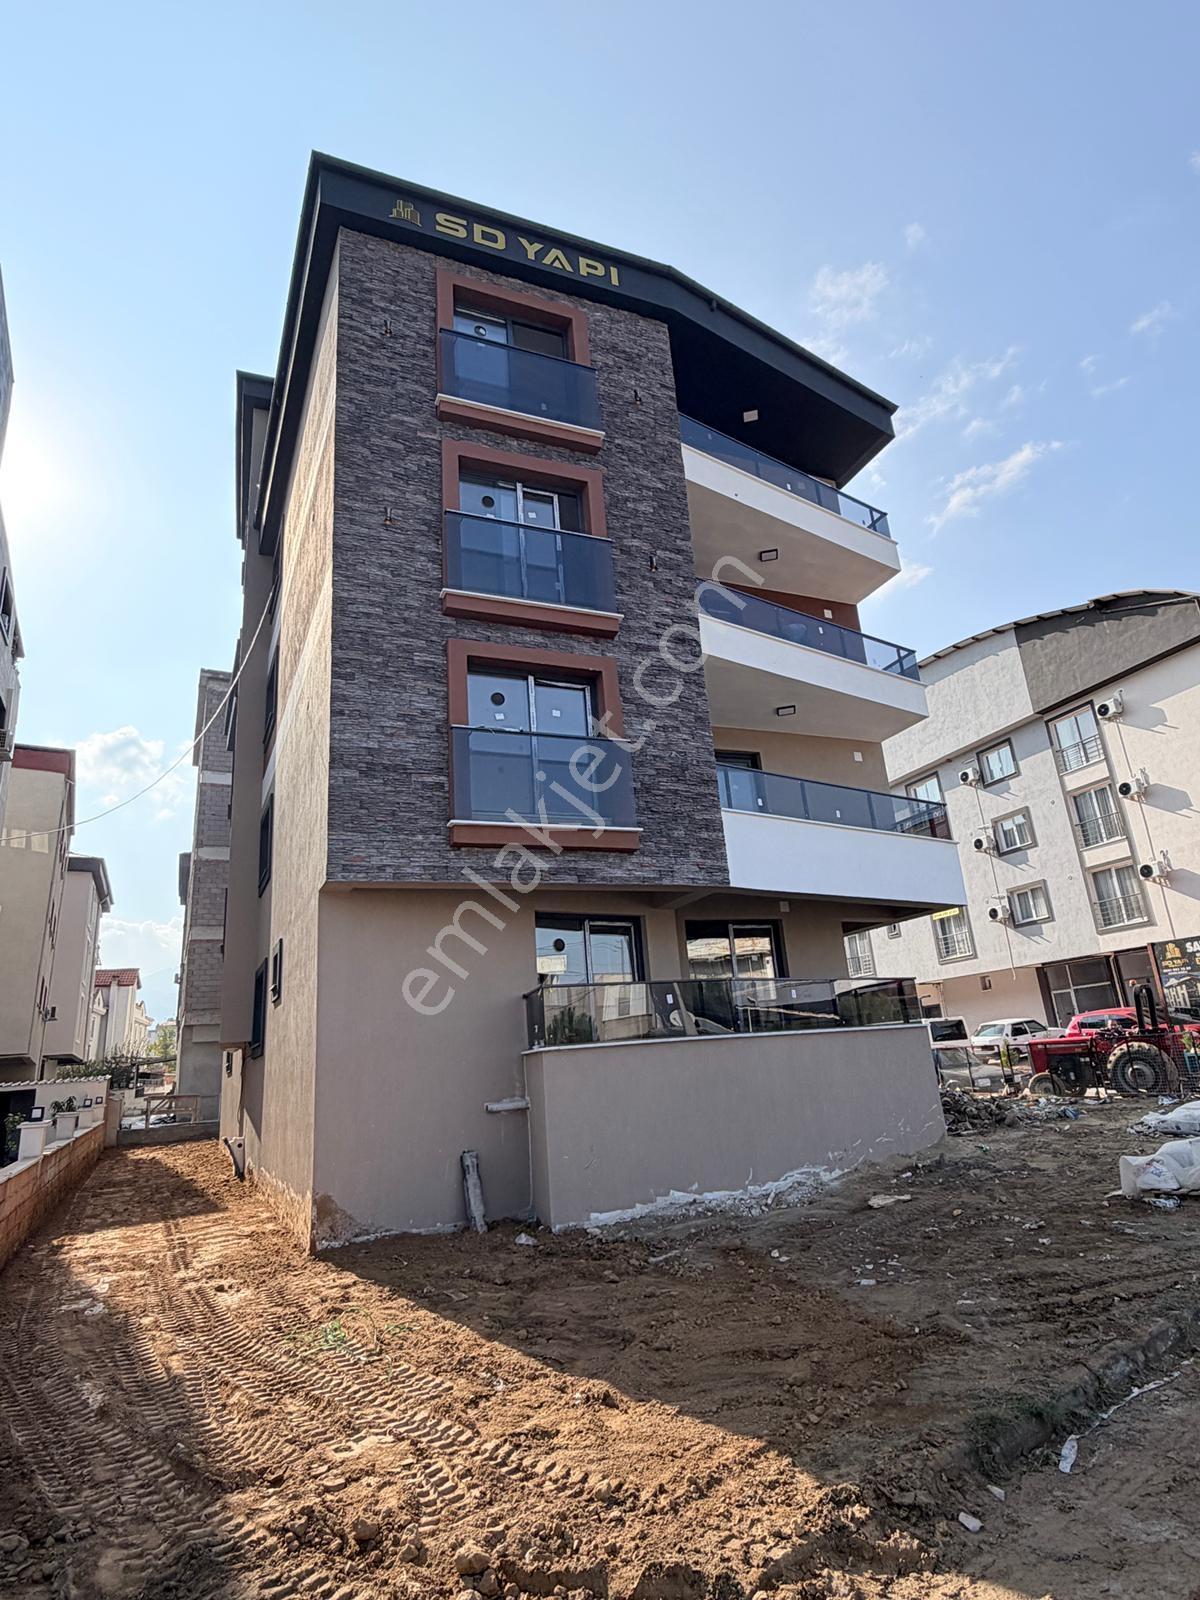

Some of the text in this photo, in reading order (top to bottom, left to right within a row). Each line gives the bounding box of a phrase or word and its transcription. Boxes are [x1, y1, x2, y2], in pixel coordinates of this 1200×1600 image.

[435, 212, 620, 287] SD YAPI
[1185, 940, 1200, 953] SA
